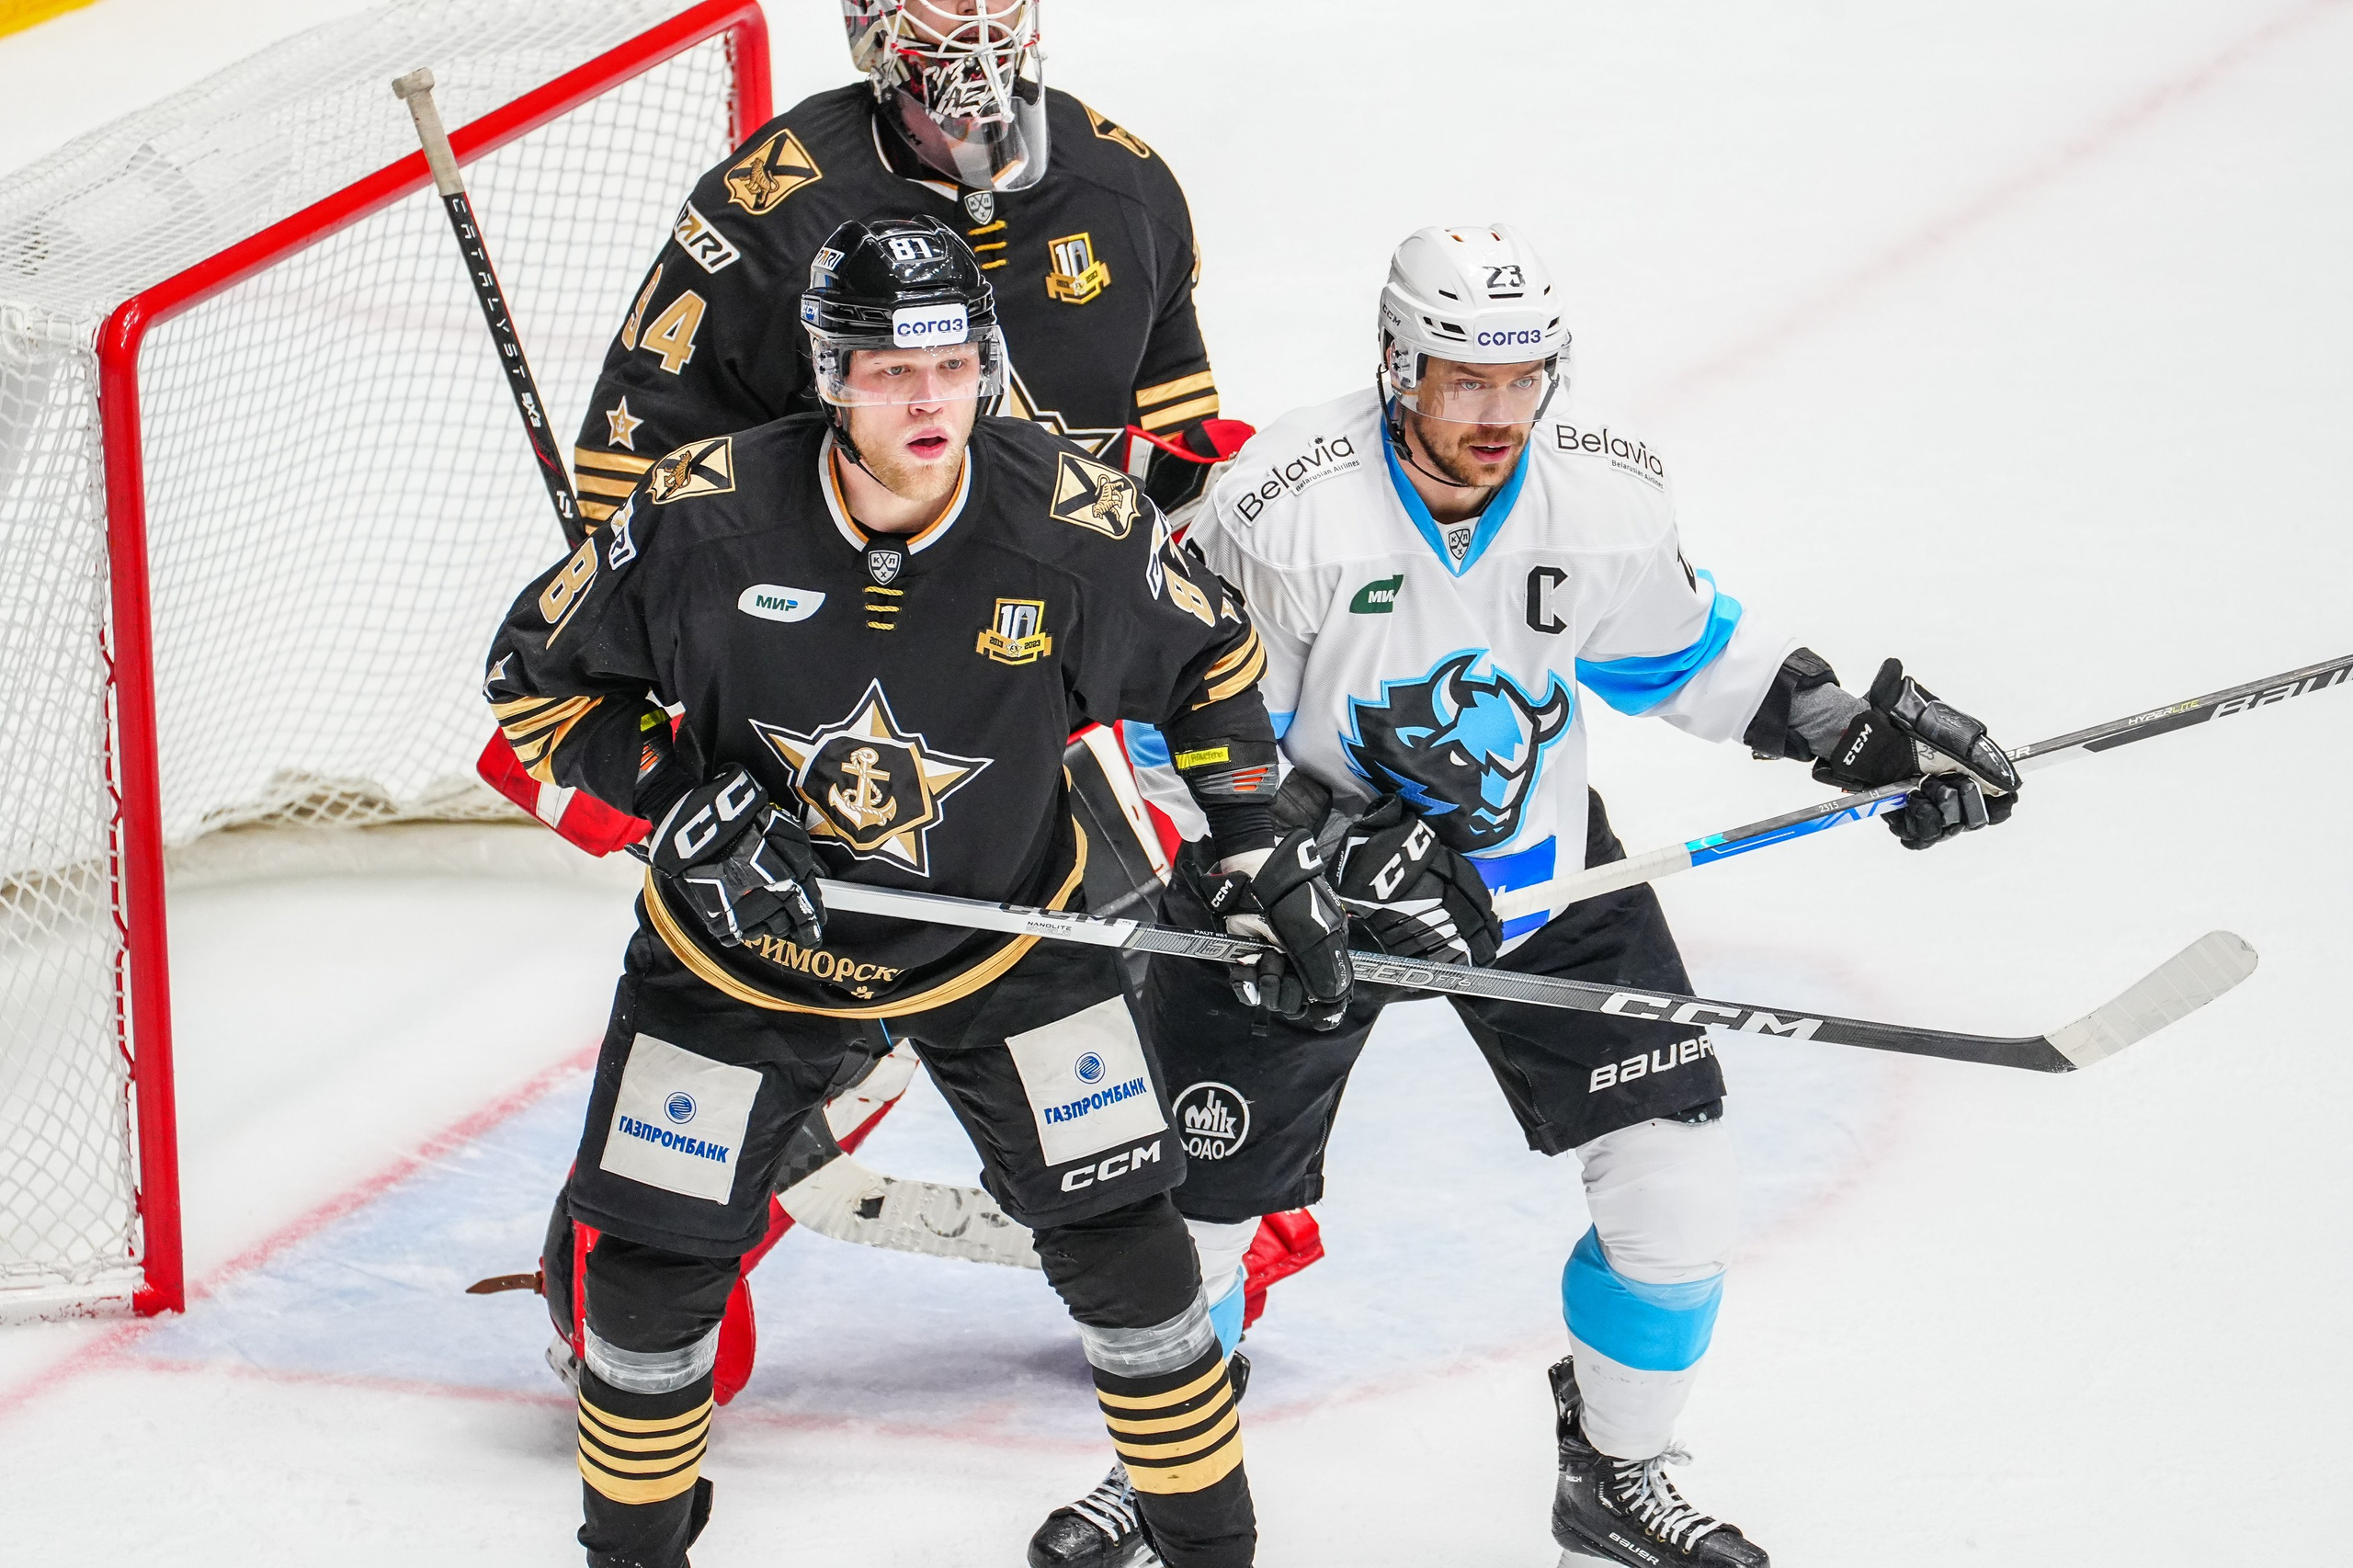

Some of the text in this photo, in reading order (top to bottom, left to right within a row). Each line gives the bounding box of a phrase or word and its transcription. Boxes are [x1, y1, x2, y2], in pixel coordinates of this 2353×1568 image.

[888, 237, 934, 261] 81
[1482, 265, 1526, 289] 23
[1381, 302, 1402, 327] CCM
[1555, 423, 1665, 478] Belavia
[1236, 436, 1355, 523] Belavia
[1295, 460, 1360, 492] Belarusian Airlines
[1611, 460, 1664, 490] Belarusian Airlines
[756, 595, 798, 612] МИР
[1368, 589, 1394, 604] МИ
[1526, 565, 1569, 635] C
[2208, 666, 2353, 722] BAU
[1842, 722, 1873, 766] CCM
[1918, 745, 1938, 761] 23
[674, 770, 763, 859] CC
[1818, 801, 1839, 813] 2315
[1369, 819, 1436, 900] CC
[1211, 879, 1234, 909] CCM
[1027, 921, 1073, 931] NANOLITE
[1434, 974, 1472, 987] FT6
[1599, 992, 1824, 1041] CCM
[1043, 1076, 1147, 1125] ГАЗПРОМБАНК
[618, 1115, 731, 1164] ГАЗПРОМБАНК
[1061, 1140, 1161, 1193] CCM
